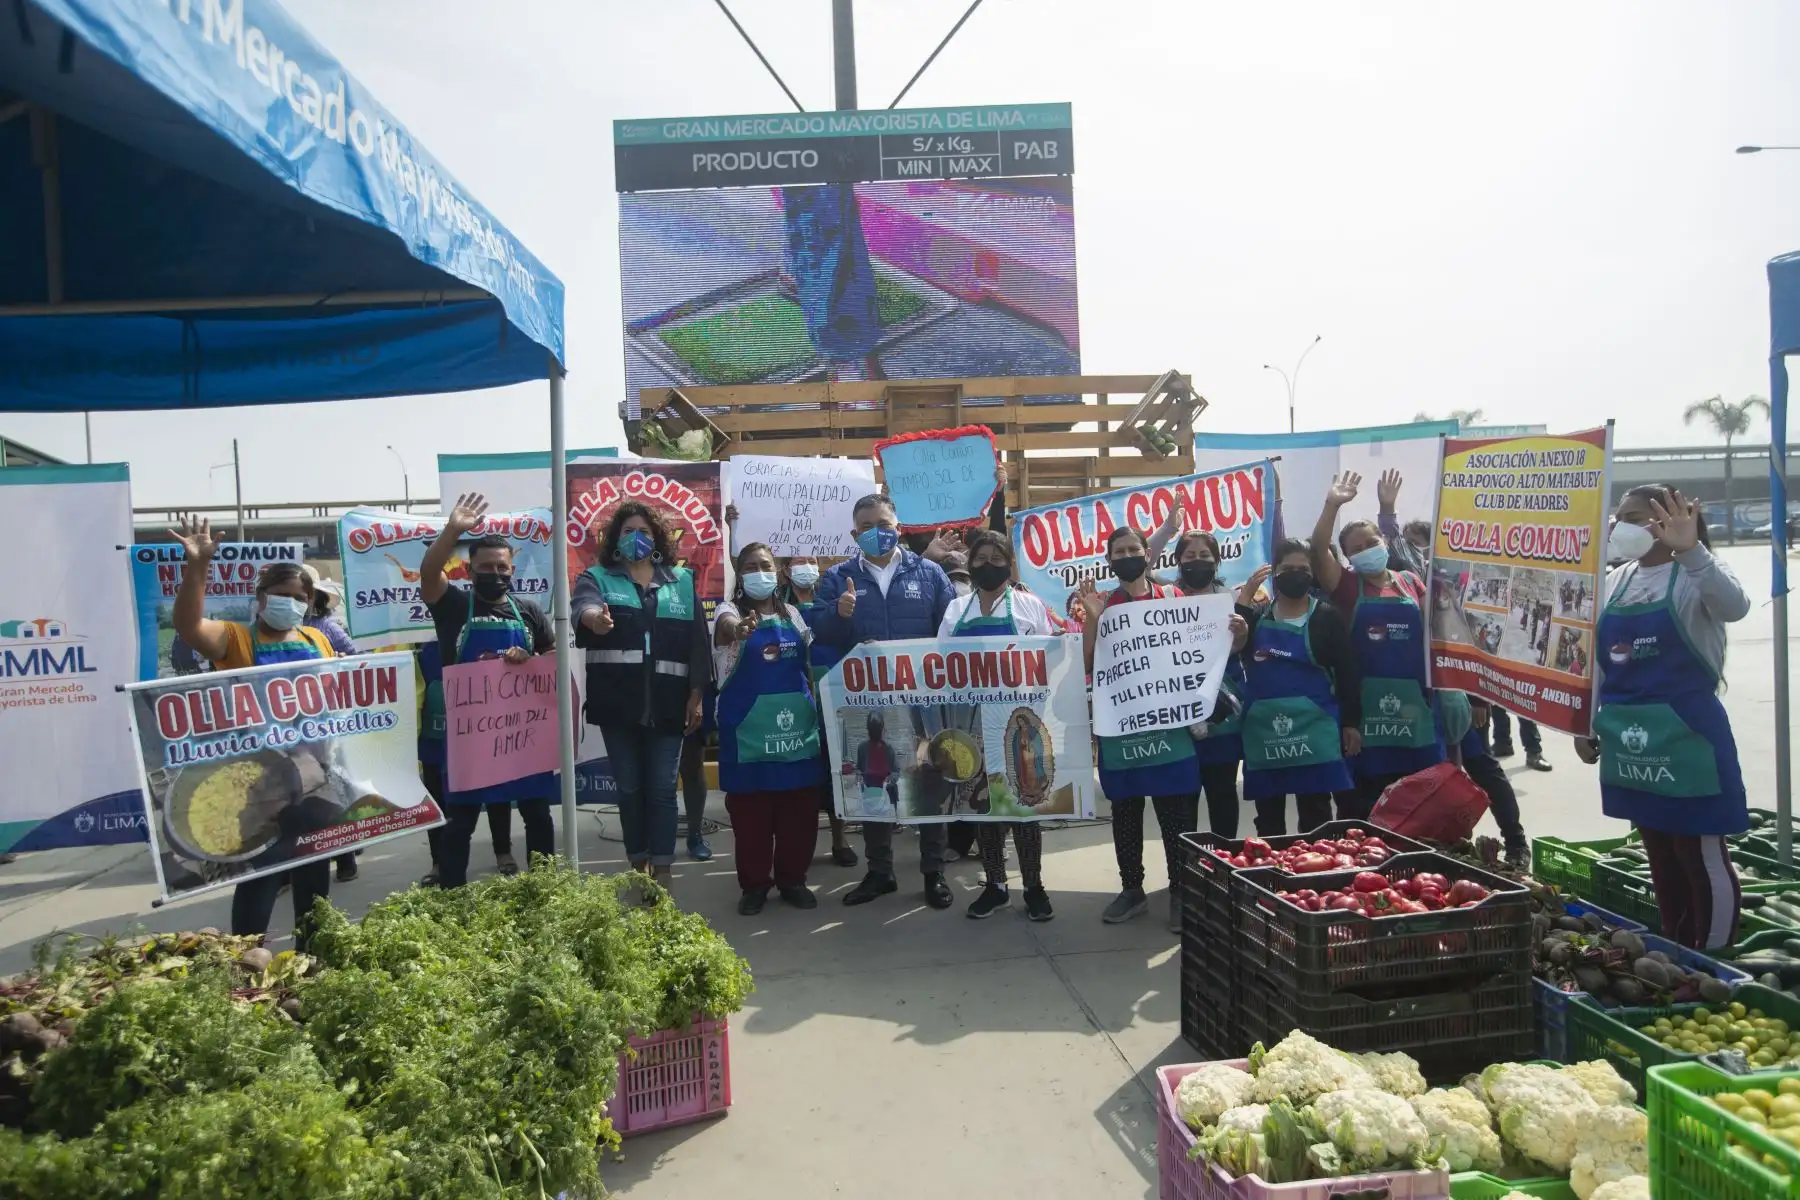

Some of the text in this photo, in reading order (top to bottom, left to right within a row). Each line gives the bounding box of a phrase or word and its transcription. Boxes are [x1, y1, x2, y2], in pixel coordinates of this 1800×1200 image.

[663, 122, 719, 138] GRAN
[724, 116, 825, 136] MERCADO
[829, 114, 943, 132] MAYORISTA
[947, 111, 973, 128] DE
[977, 109, 1026, 128] LIMA
[948, 136, 975, 154] Kg.
[1014, 140, 1058, 160] PAB
[692, 149, 819, 172] PRODUCTO
[897, 157, 993, 175] MIN MAX
[1465, 449, 1586, 469] ASOCIACIÓN ANEXO 18
[743, 460, 844, 480] GRACIAS A LA
[1443, 471, 1601, 489] CARAPONGO ALTO MATABUEY
[741, 480, 851, 503] MUNICIPALIDAD
[1474, 493, 1569, 511] CLUB DE MADRES
[567, 471, 721, 546] OLLA COMUN
[792, 503, 812, 517] DE
[1022, 466, 1265, 568] OLLA COMUN
[349, 514, 553, 552] OLLA OMÚN
[780, 517, 812, 532] LIMA
[768, 531, 790, 545] OLLA
[136, 548, 187, 563] OLL
[811, 545, 837, 556] MAYO
[355, 586, 422, 608] SANTA
[1100, 605, 1200, 638] OLLA COMUN
[1112, 630, 1182, 658] PRIMERA
[0, 645, 97, 678] MML
[842, 643, 1049, 693] OLLA COMÚN
[1096, 649, 1205, 688] PARCELA LOS
[28, 682, 84, 695] Mercado
[498, 671, 558, 700] COMUN
[1110, 672, 1207, 707] TULIPANES
[1516, 681, 1537, 697] ALTO
[1541, 687, 1571, 707] ANEXO
[49, 694, 64, 705] de
[67, 692, 97, 704] Lima
[156, 661, 399, 740] OLLA COMÚN
[949, 691, 965, 703] de
[456, 718, 473, 736] LA
[1117, 701, 1204, 733] PRESENTE
[266, 724, 297, 746] de
[301, 711, 398, 739] Estrellas
[1364, 723, 1413, 737] LIMA
[493, 727, 537, 758] AMOR
[765, 737, 804, 754] LIMA
[1122, 740, 1172, 760] LIMA
[1264, 743, 1313, 760] LIMA
[1617, 760, 1676, 782] LIMA
[594, 779, 617, 791] LIM
[103, 814, 148, 830] LIMA
[296, 804, 430, 847] Asociación Marino Segovia
[314, 830, 371, 851] Carapongo
[379, 818, 418, 833] chosica
